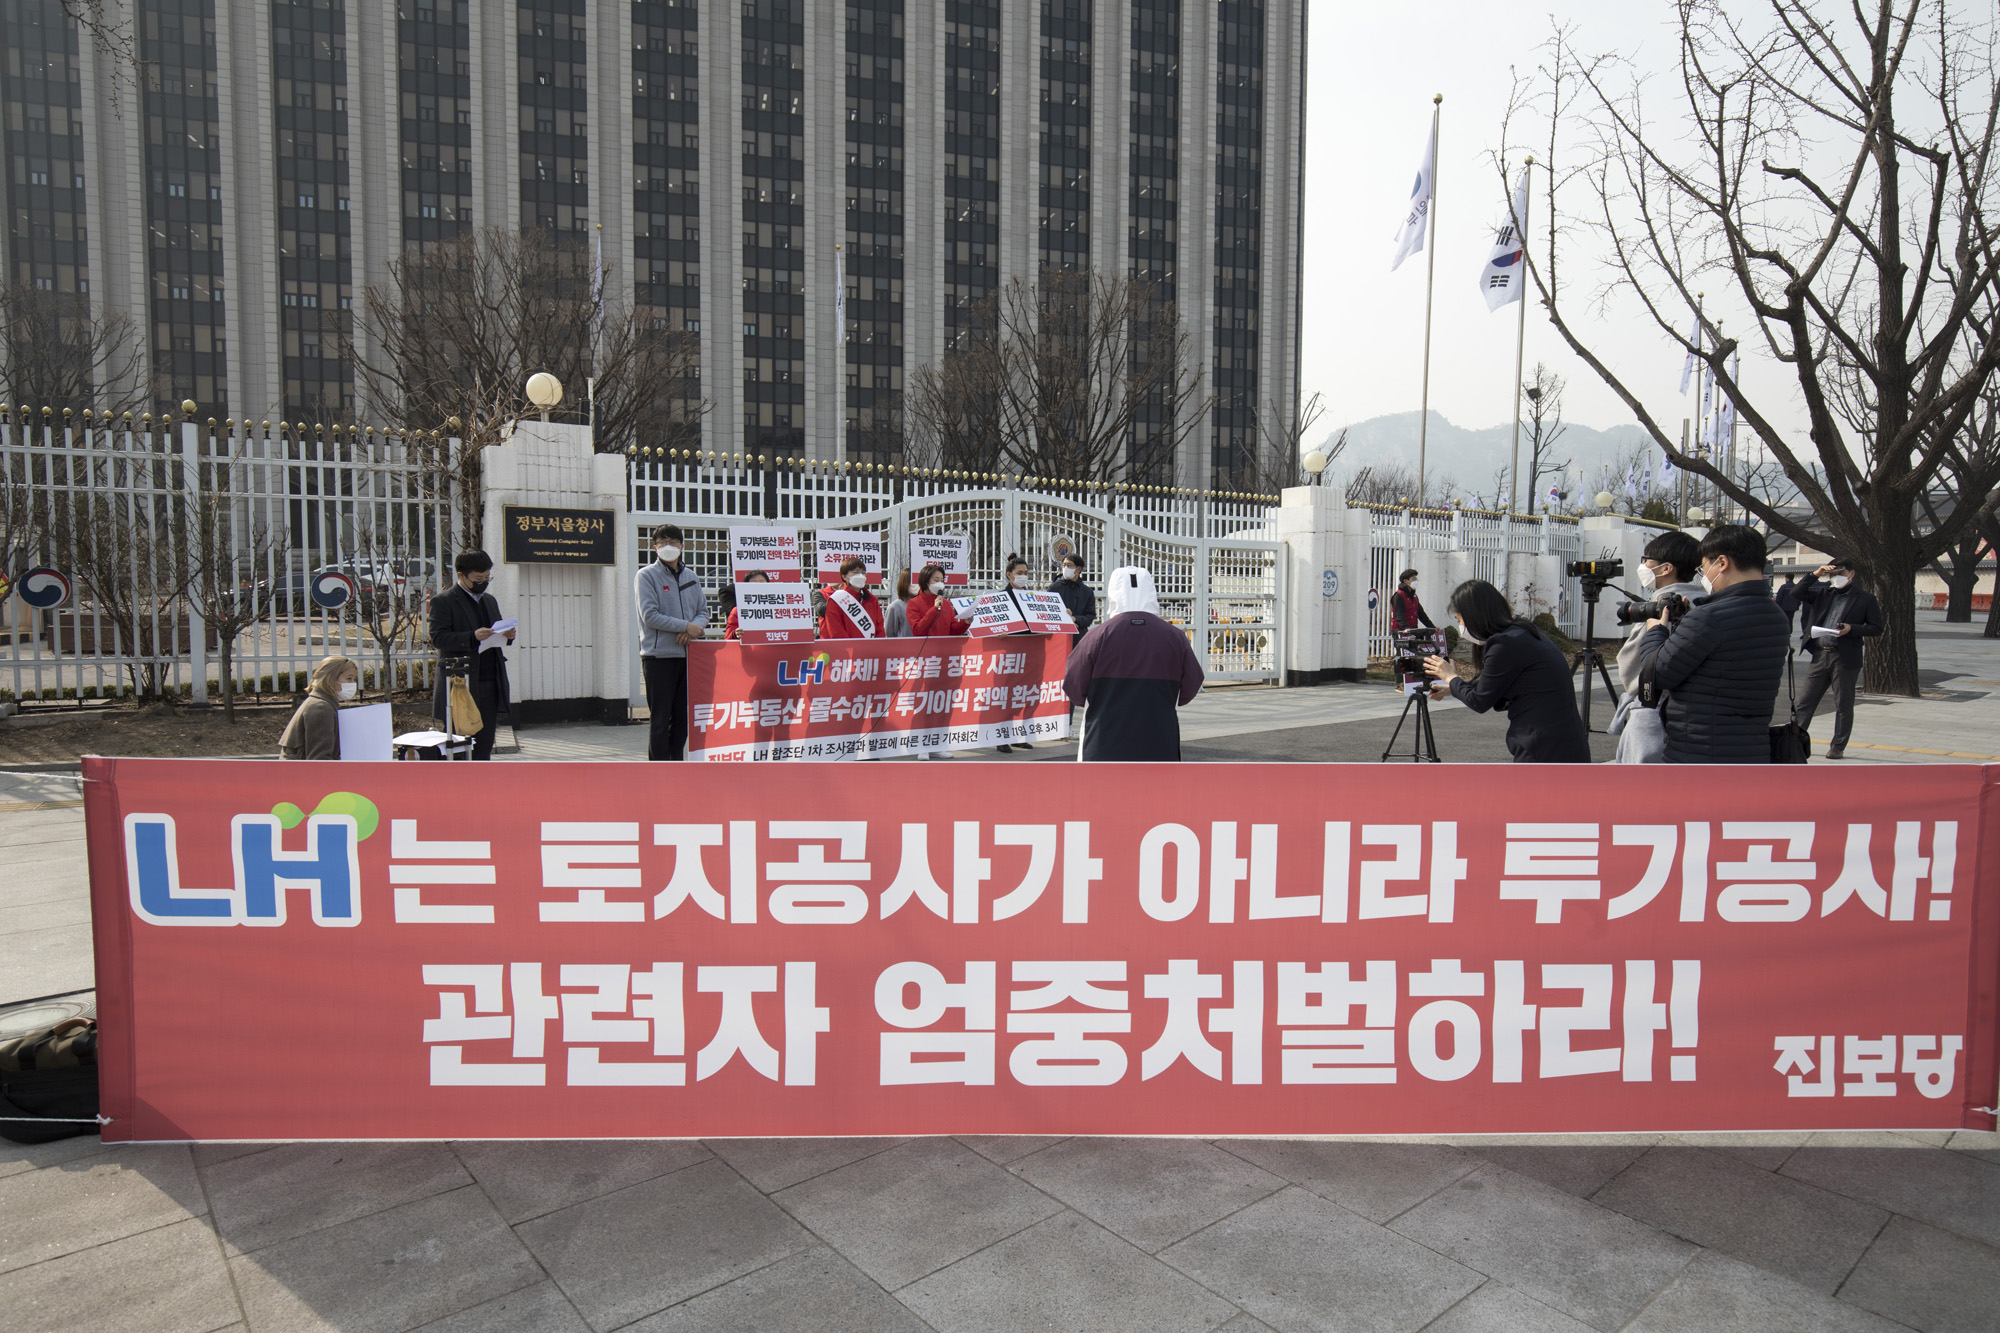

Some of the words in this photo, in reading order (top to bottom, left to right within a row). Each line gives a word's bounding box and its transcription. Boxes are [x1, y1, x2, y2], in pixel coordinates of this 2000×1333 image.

[516, 515, 605, 534] 정부서울청사
[740, 536, 777, 547] 투기부동산
[778, 536, 794, 547] 몰수!
[819, 540, 842, 550] 공직자
[843, 541, 861, 551] 1가구
[862, 542, 880, 552] 1주택
[918, 537, 940, 547] 공직자
[941, 539, 962, 548] 부동산
[736, 549, 766, 560] 투기이익
[767, 549, 782, 560] 전액
[783, 549, 800, 560] 환수!
[923, 549, 957, 559] 백지신탁제
[1323, 581, 1336, 589] 209
[744, 593, 785, 605] 투기부동산
[786, 593, 805, 604] 몰수!
[1019, 592, 1036, 602] LH
[1035, 594, 1061, 604] 해체하고
[992, 603, 1010, 613] 장관
[1026, 602, 1047, 612] 변창흠
[1047, 604, 1061, 613] 장관
[740, 608, 773, 620] 투기이익
[774, 608, 791, 619] 전액
[792, 607, 811, 619] 환수!
[979, 613, 1010, 624] 사퇴하라
[1036, 612, 1062, 622] 사퇴하라
[989, 624, 1009, 634] 진보당
[765, 631, 789, 641] 진보당
[777, 659, 825, 686] LH
[830, 657, 878, 683] 해체!
[885, 655, 942, 681] 변창흠
[947, 654, 984, 678] 장관
[986, 653, 1026, 675] 사퇴!
[693, 698, 806, 733] 투기부동산
[809, 693, 893, 724] 몰수하고
[895, 687, 970, 717] 투기이익
[973, 686, 1008, 712] 전액
[753, 749, 768, 761] LH
[771, 746, 805, 760] 합조단
[808, 743, 823, 757] 1차
[825, 739, 866, 755] 조사결과
[868, 736, 898, 751] 발표에
[900, 735, 919, 749] 따른
[921, 733, 940, 747] 긴급
[942, 731, 979, 745] 기자회견
[995, 726, 1010, 739] 3월
[1012, 725, 1027, 737] 11일
[1029, 723, 1043, 735] 오후
[1045, 720, 1059, 733] 3시
[538, 820, 1103, 924] 토지공사가
[1138, 821, 1468, 923] 아니라
[1500, 821, 1958, 924] 투기공사!
[422, 961, 830, 1086] 관련자
[874, 959, 1701, 1086] 엄중처벌하라!
[1773, 1035, 1963, 1099] 진보당
